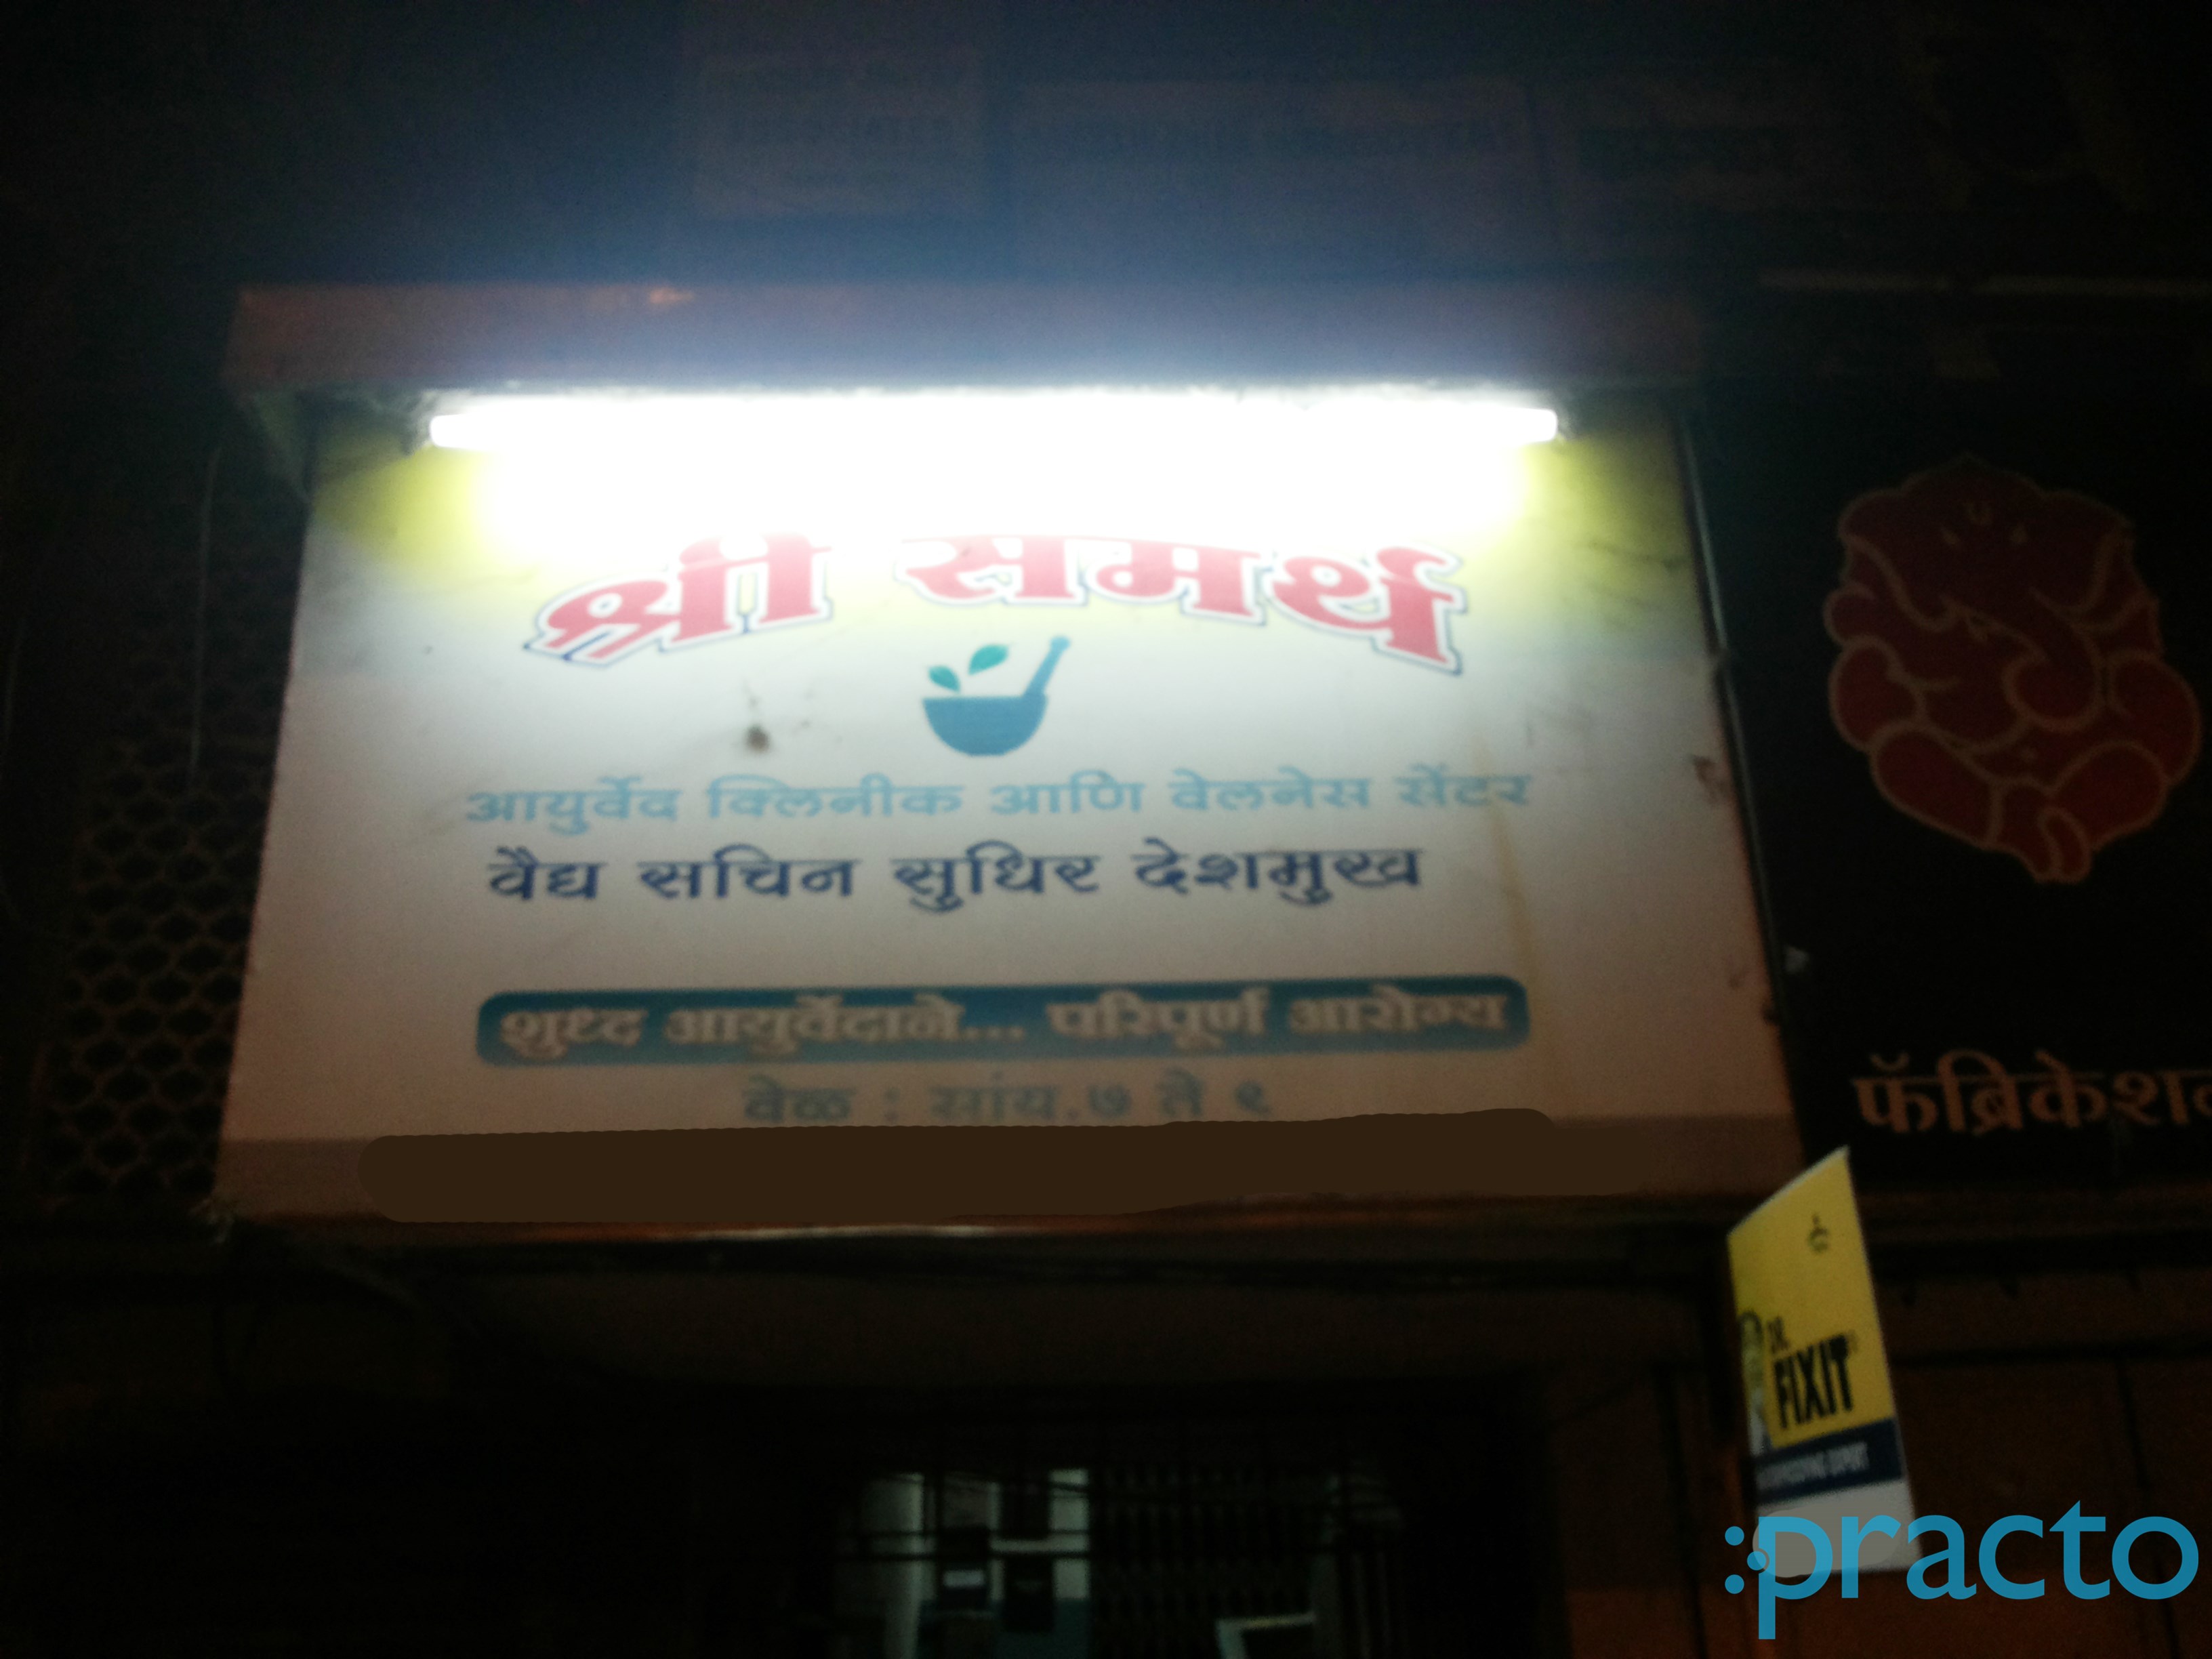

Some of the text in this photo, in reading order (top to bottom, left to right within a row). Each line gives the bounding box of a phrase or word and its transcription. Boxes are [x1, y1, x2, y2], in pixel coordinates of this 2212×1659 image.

[523, 530, 1468, 675] श्री समर्थ
[466, 762, 1533, 836] आयुर्वेद क्लिनीक आणि वेलनेस सेंटर
[487, 836, 1425, 914] वैद्य सचिन सुधिर देशमुख
[1045, 987, 1271, 1052] परिपूर्ण
[1288, 983, 1509, 1034] आरोग्य
[1771, 1332, 1856, 1430] FIXIT
